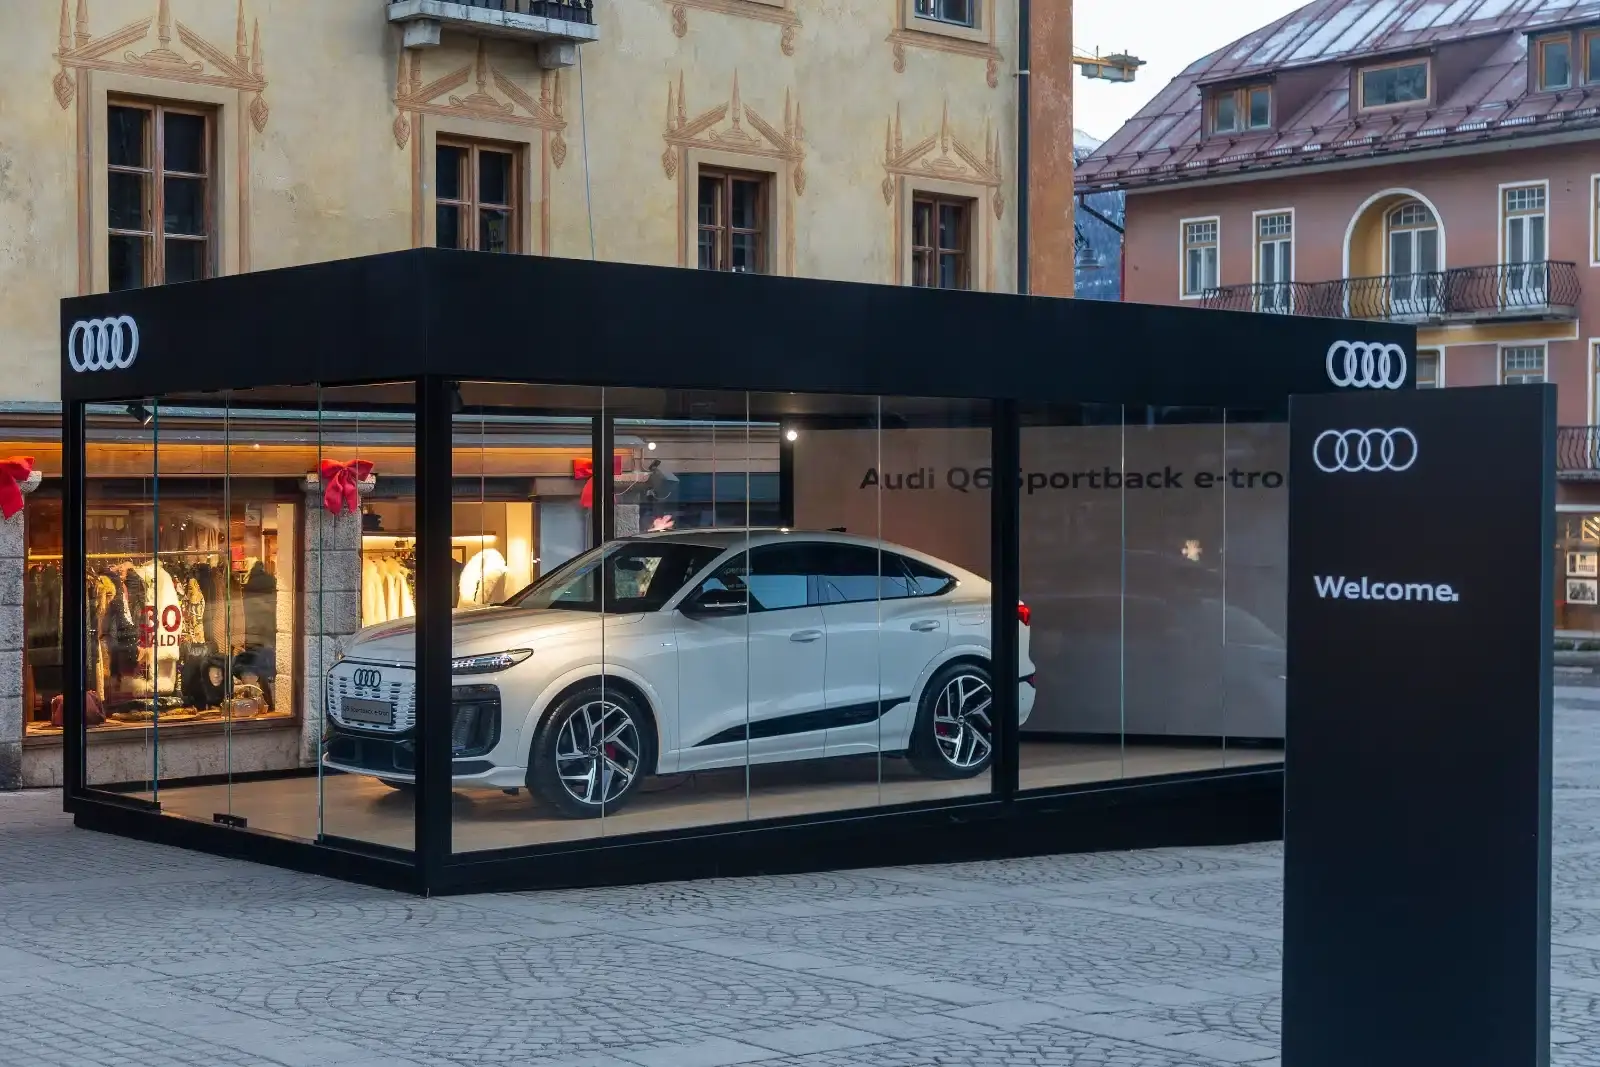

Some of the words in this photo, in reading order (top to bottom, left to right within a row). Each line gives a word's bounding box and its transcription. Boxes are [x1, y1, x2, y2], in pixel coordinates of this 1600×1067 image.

[860, 467, 935, 490] Audi
[946, 467, 992, 493] Q6
[1019, 466, 1184, 495] portback
[1193, 467, 1289, 489] e-tro
[1313, 575, 1460, 602] Welcome.
